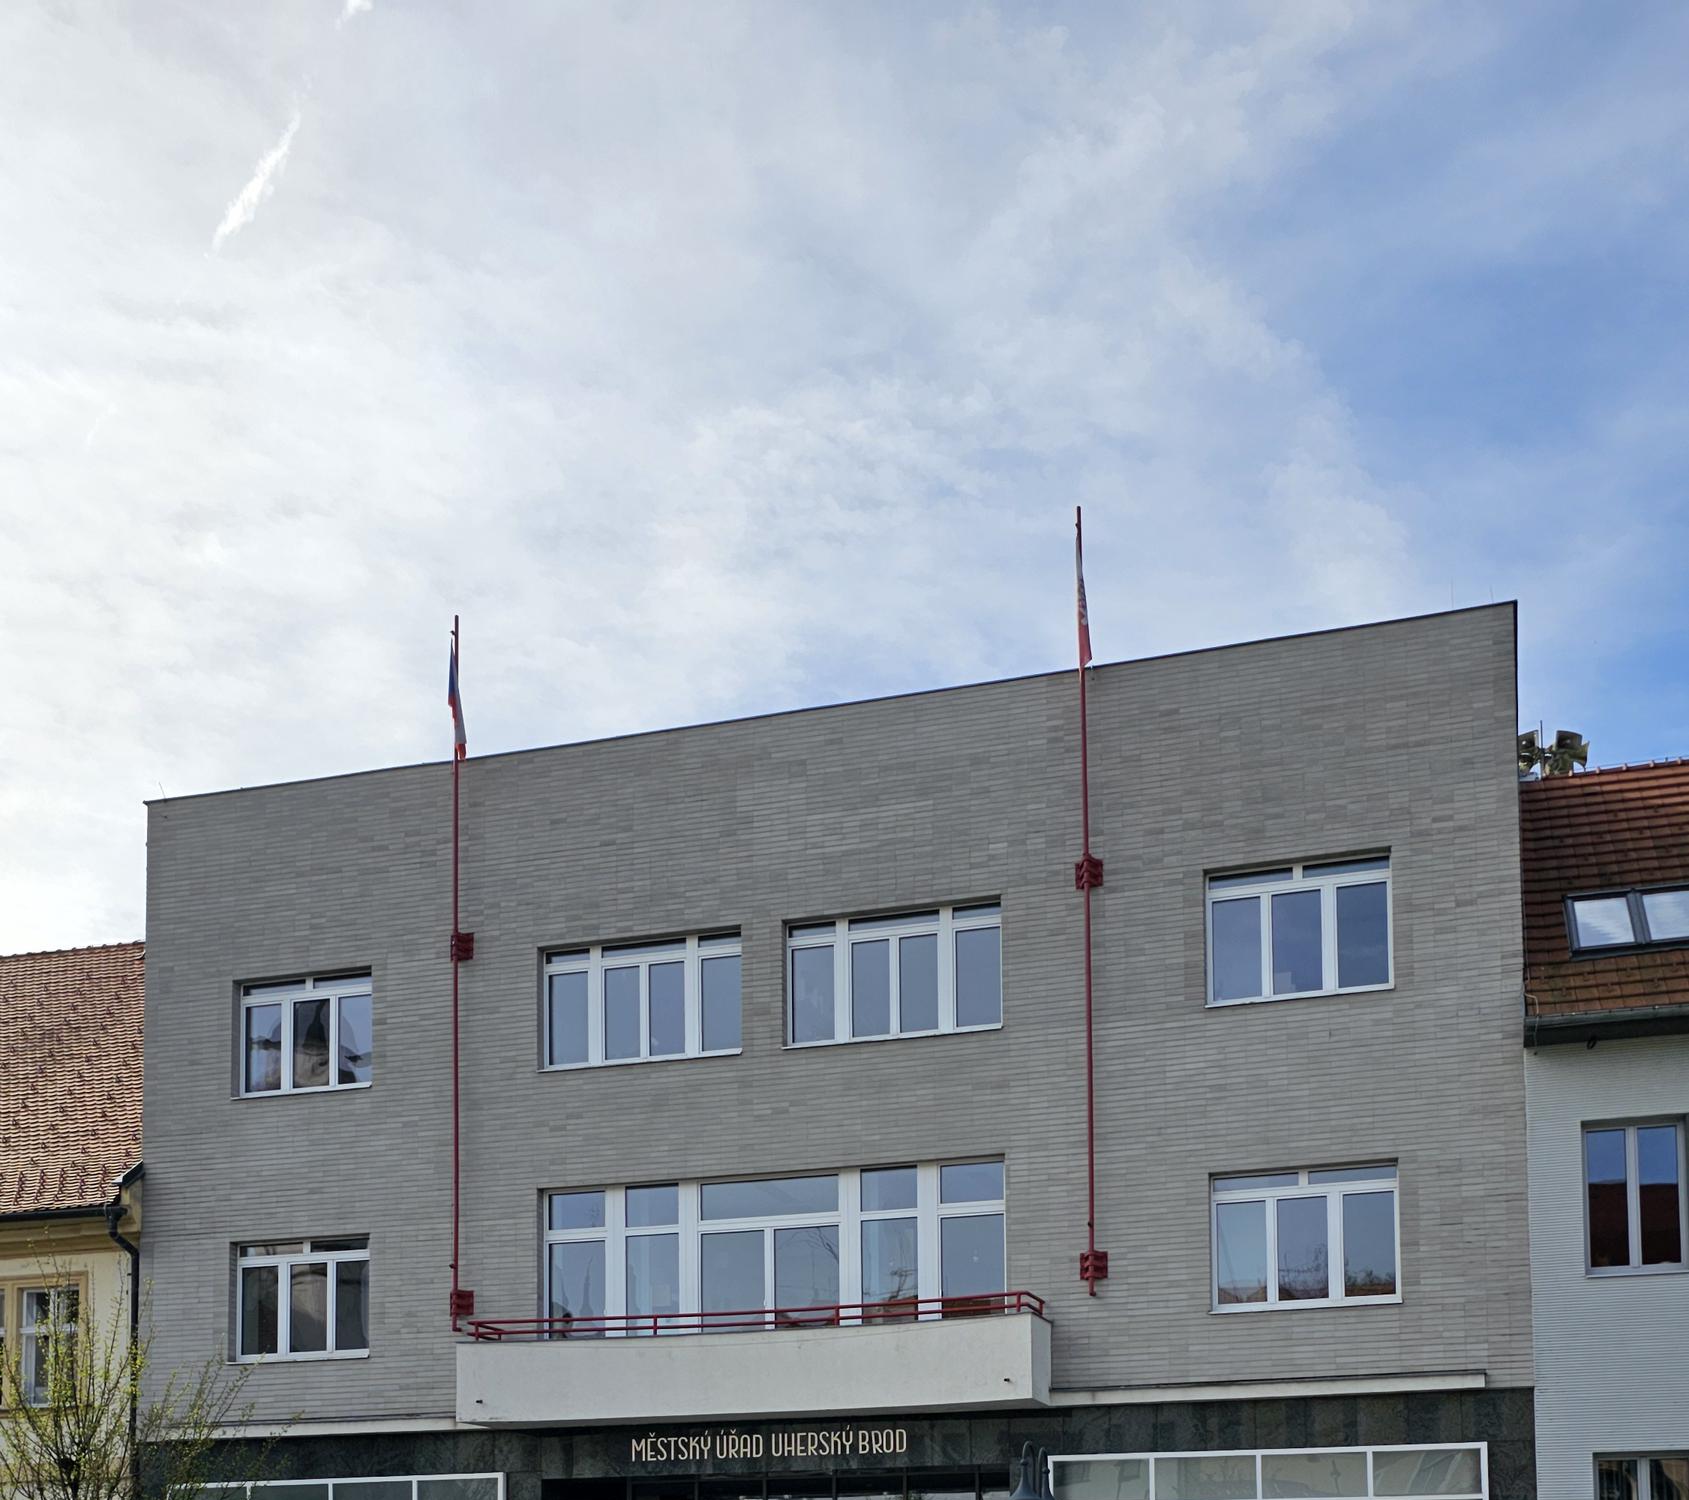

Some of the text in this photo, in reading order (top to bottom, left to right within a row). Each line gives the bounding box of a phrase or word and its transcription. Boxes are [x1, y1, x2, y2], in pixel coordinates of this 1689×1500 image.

[631, 1425, 907, 1462] MĚSTSKÝ ÚŘAD UHERSKÝ BROD
